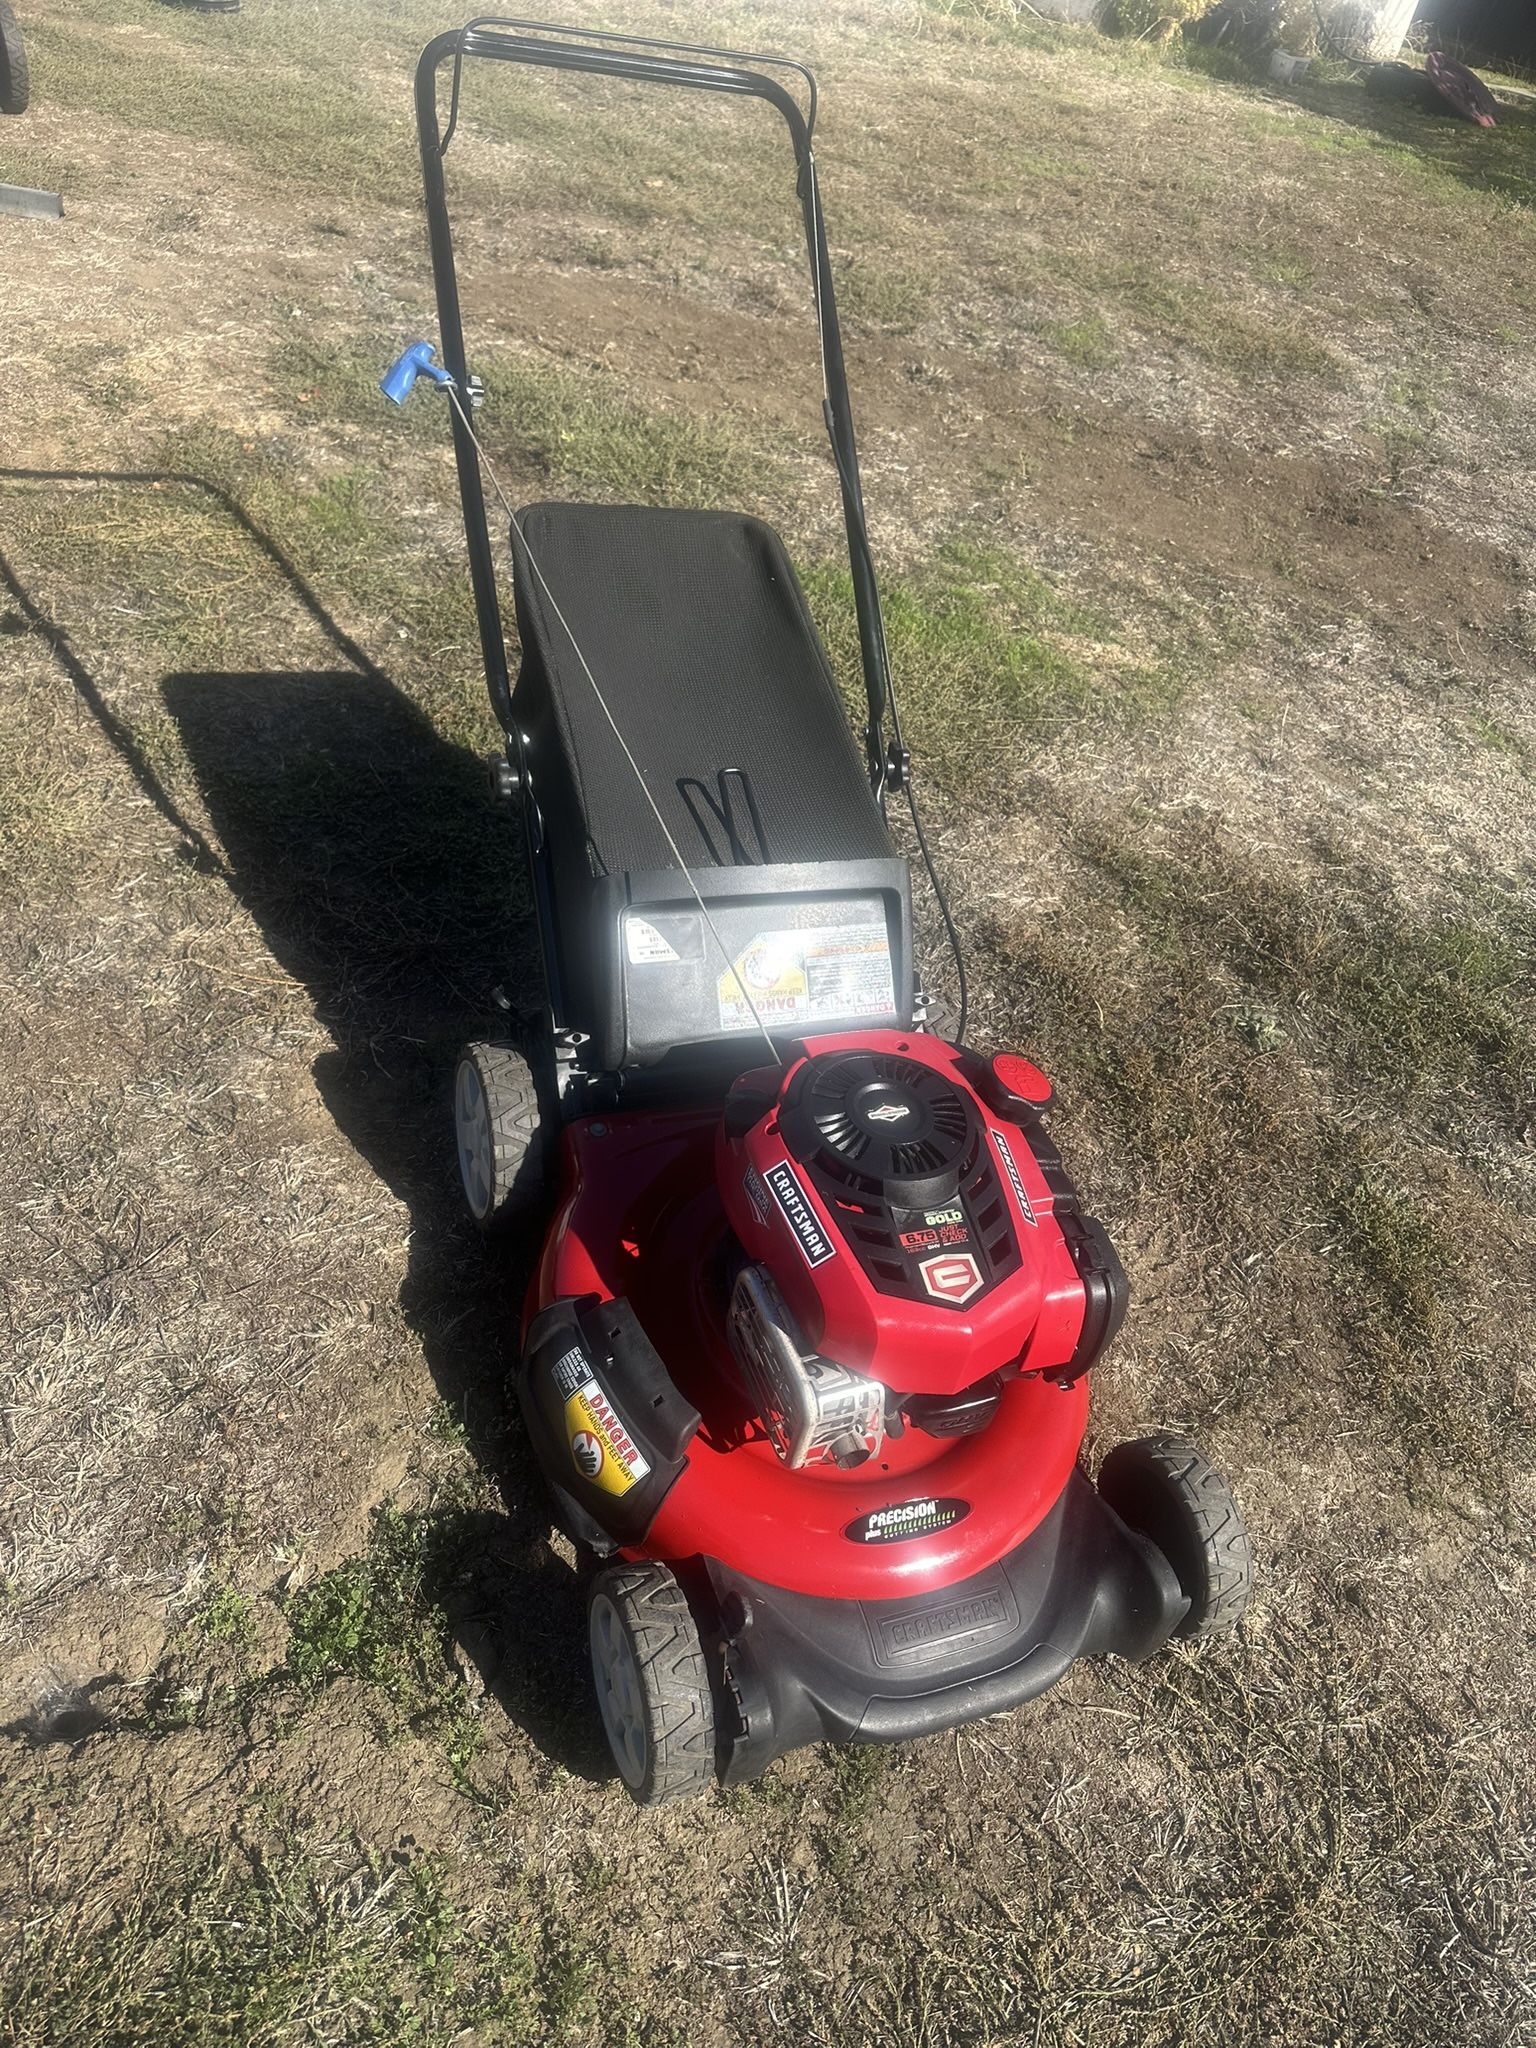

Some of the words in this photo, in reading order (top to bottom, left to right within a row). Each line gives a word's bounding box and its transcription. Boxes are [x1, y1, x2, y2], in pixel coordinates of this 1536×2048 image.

[995, 1134, 1032, 1219] CRAFTSMAN
[773, 1170, 827, 1257] CRAFTSMAN
[925, 1211, 963, 1226] GOLD
[905, 1230, 936, 1244] 6.75
[939, 1224, 958, 1233] JUST
[940, 1227, 968, 1238] CHECK
[950, 1233, 967, 1241] ADD
[578, 1394, 591, 1415] KEEP
[586, 1409, 602, 1435] HANDS
[599, 1433, 609, 1448] and
[606, 1443, 622, 1464] FEET
[617, 1458, 635, 1482] AWAY
[589, 1393, 639, 1467] DANGER
[868, 1501, 937, 1529] PRECISION
[865, 1528, 882, 1541] plus
[890, 1599, 998, 1645] CRAFTSMAN
